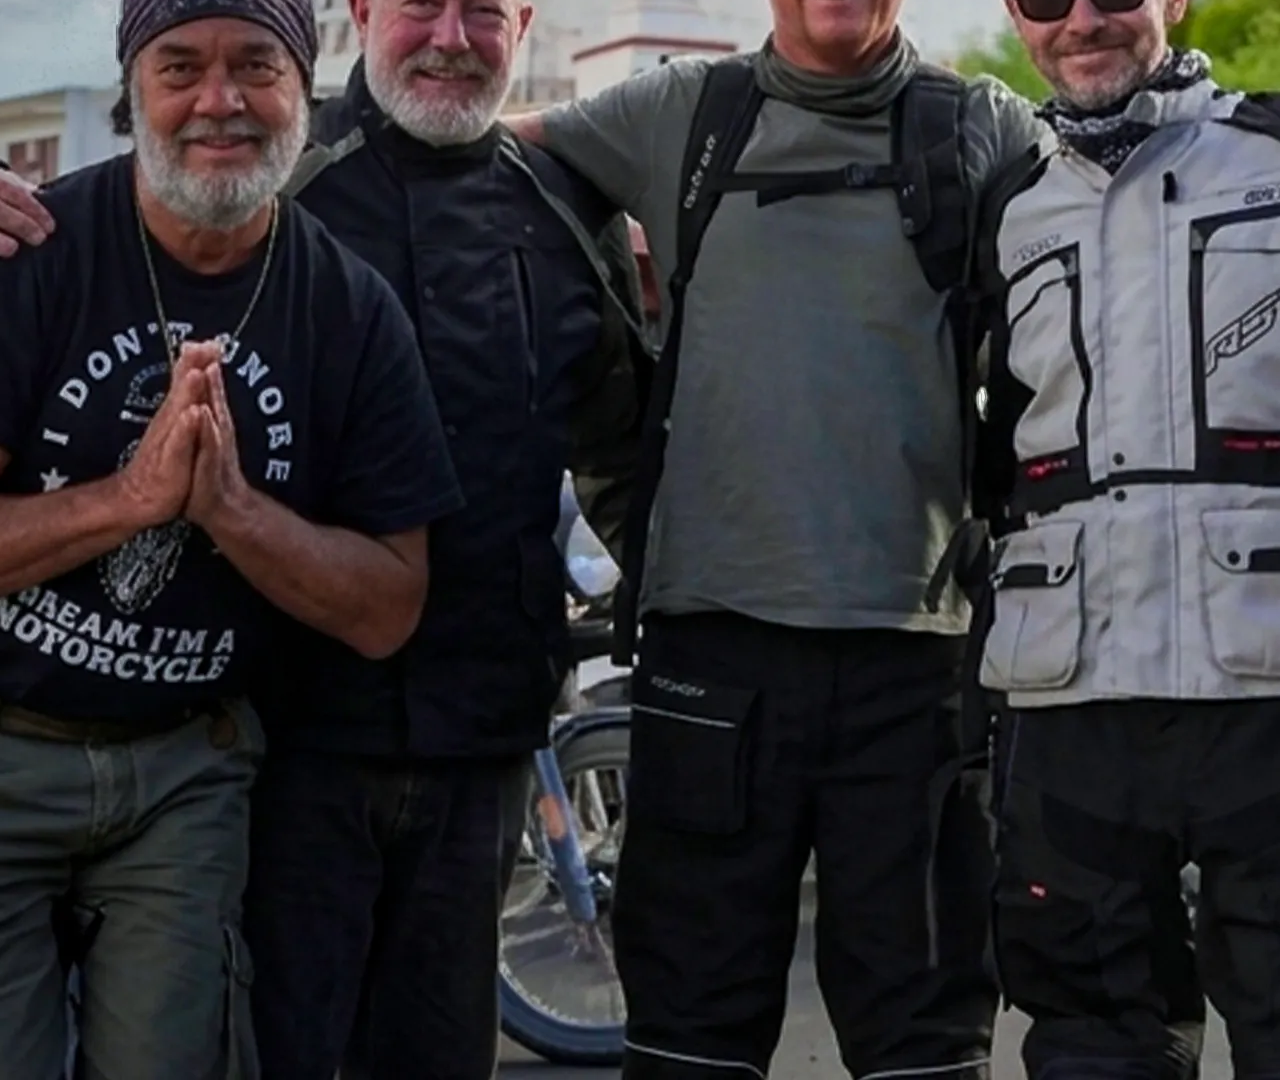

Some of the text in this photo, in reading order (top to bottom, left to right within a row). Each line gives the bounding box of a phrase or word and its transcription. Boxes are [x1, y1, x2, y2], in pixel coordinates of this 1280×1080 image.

[43, 427, 69, 446] I
[59, 321, 194, 409] DON'T
[148, 626, 208, 654] I'M
[213, 628, 235, 653] A
